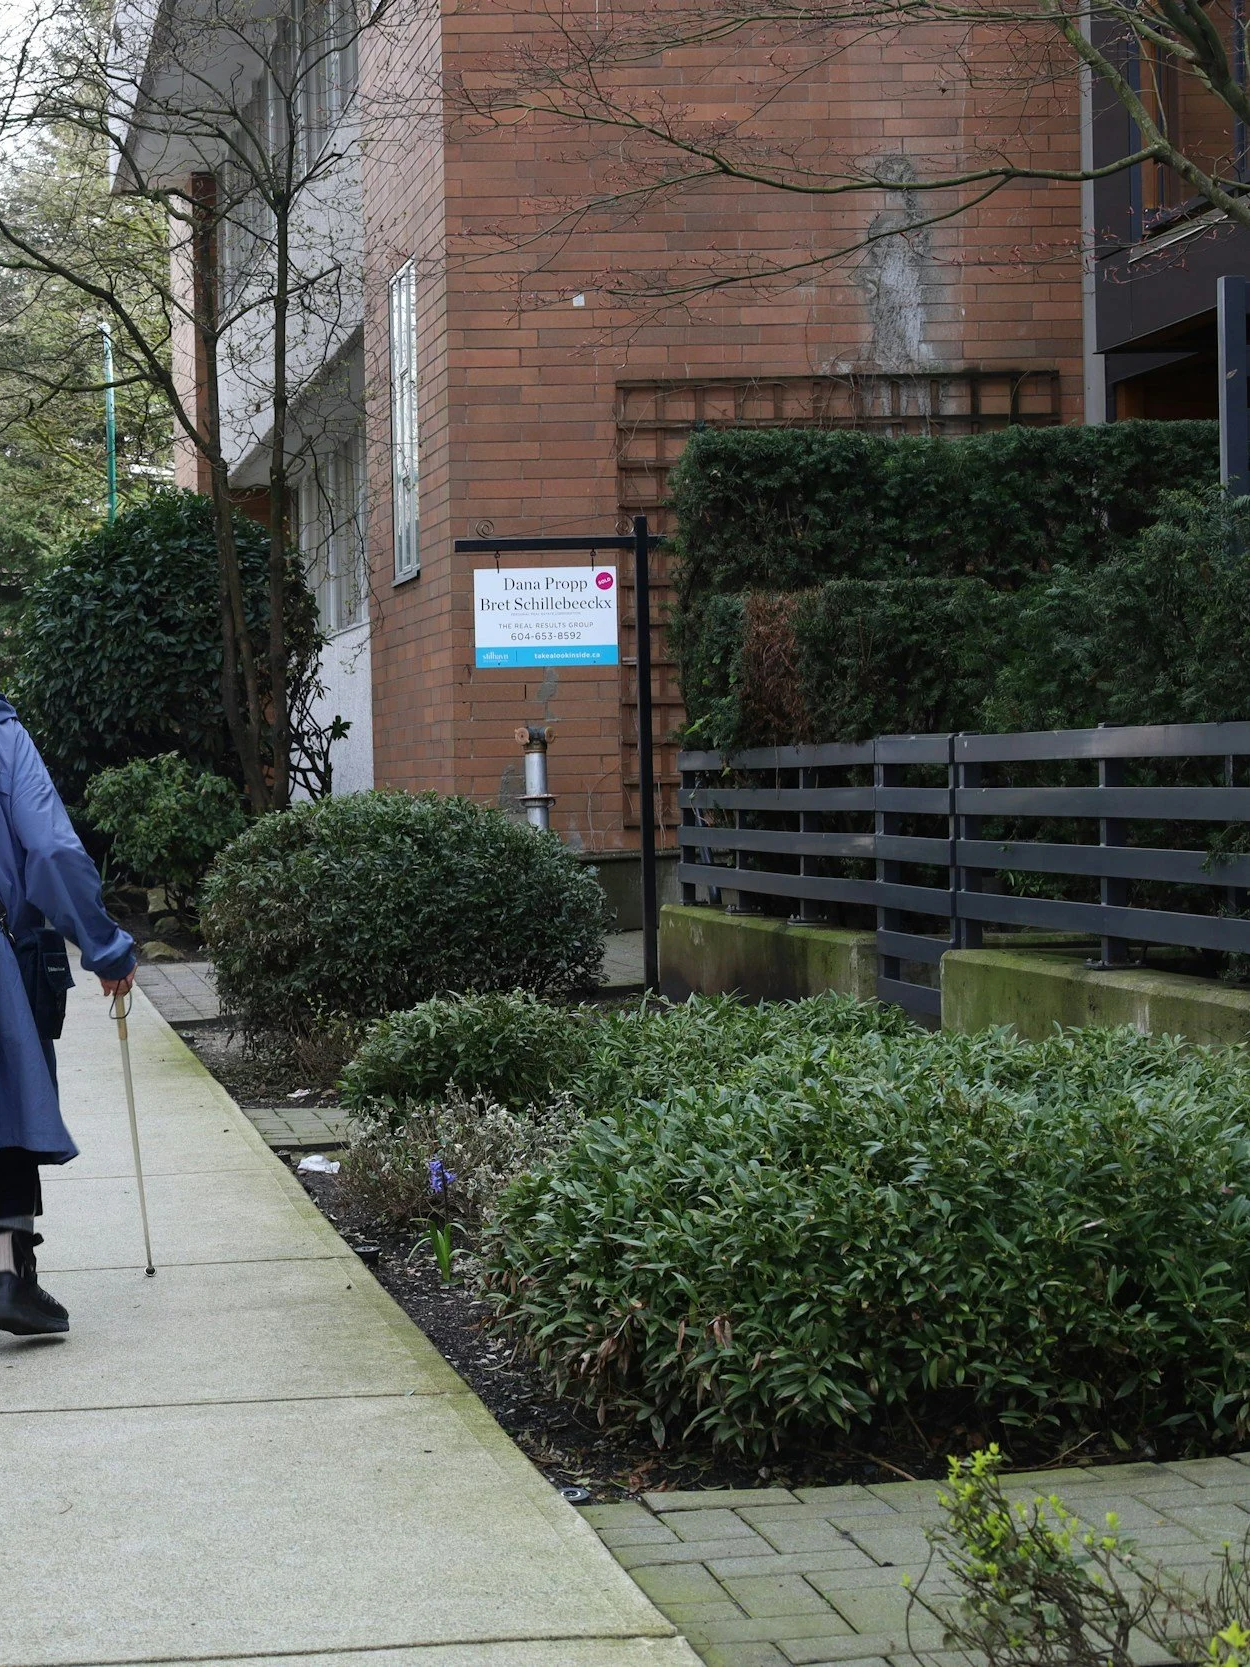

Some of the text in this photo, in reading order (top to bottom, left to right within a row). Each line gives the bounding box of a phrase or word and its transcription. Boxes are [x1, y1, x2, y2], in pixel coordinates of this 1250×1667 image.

[504, 576, 588, 592] Dana Propp
[598, 577, 611, 585] SOLD
[480, 596, 612, 611] Bret Schillebeeckx
[510, 632, 581, 641] 604-653-8592
[534, 652, 600, 660] takealookinside.ca
